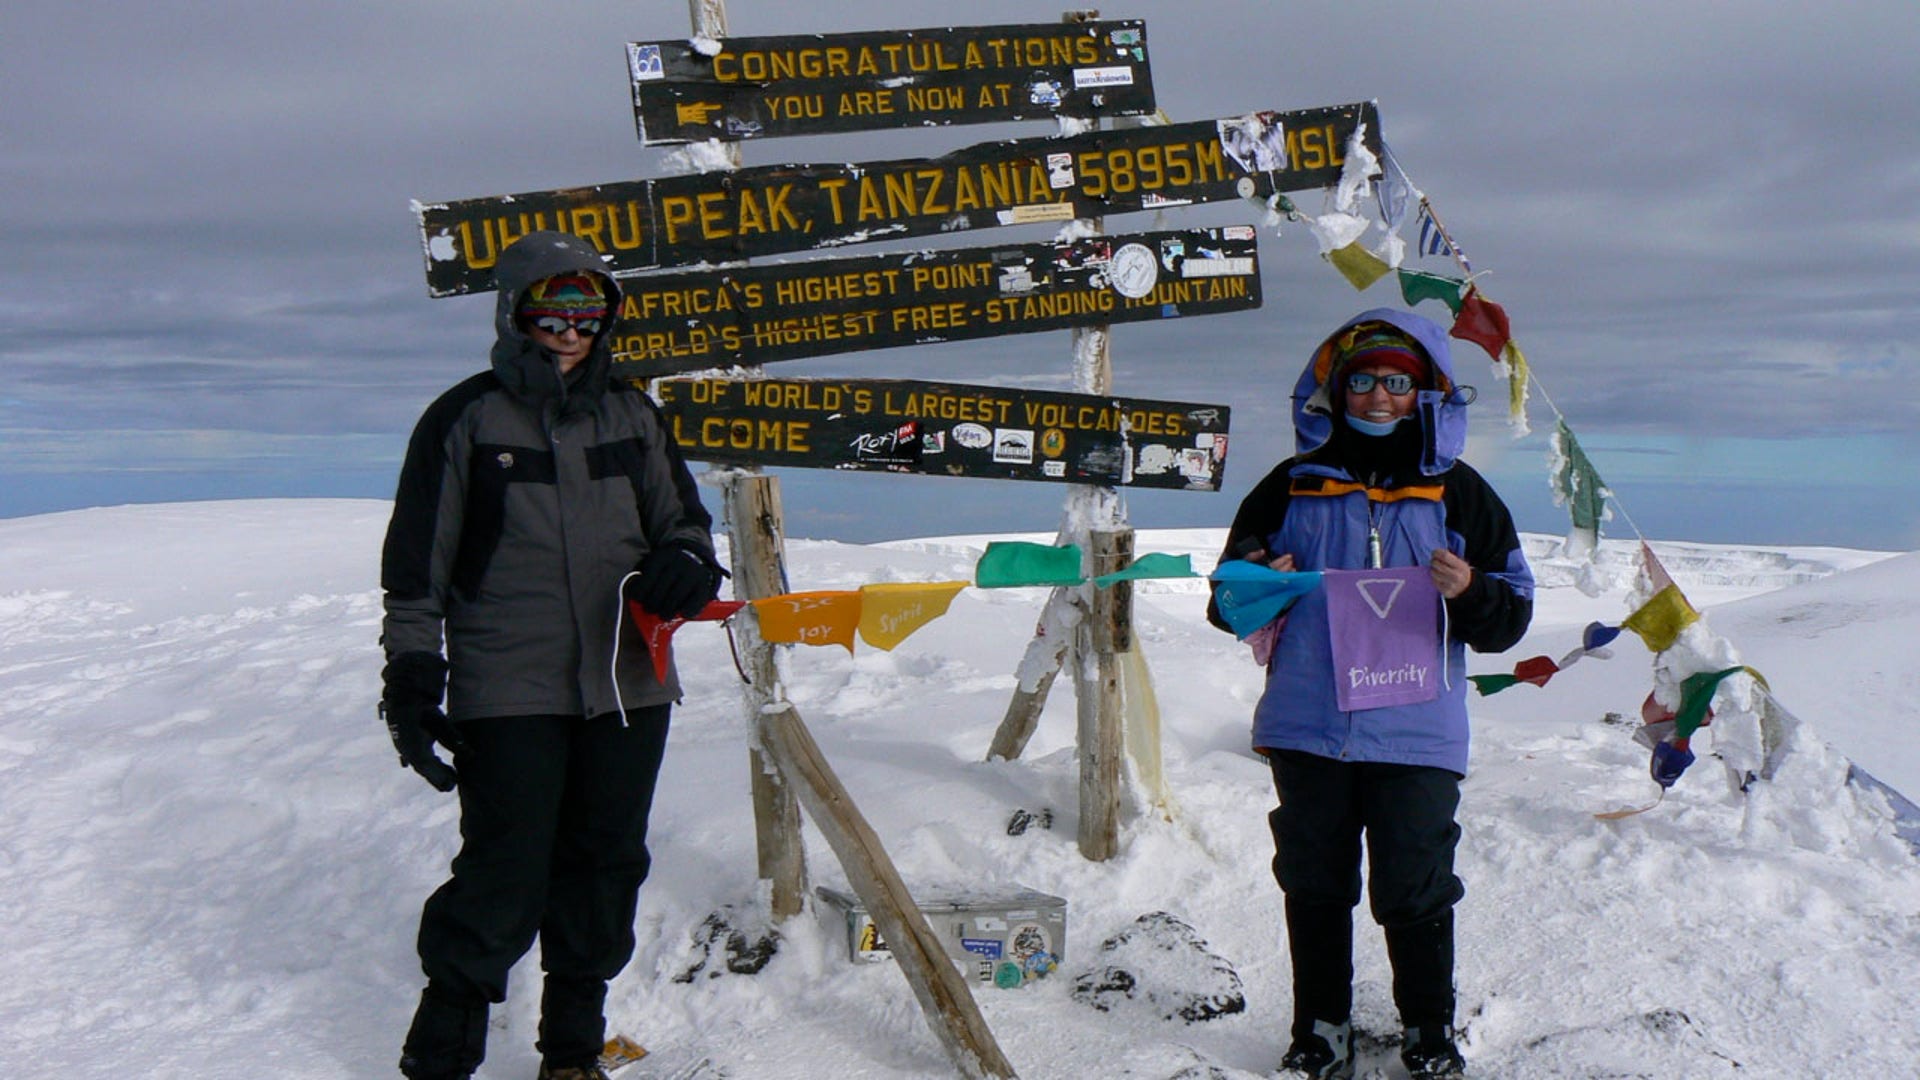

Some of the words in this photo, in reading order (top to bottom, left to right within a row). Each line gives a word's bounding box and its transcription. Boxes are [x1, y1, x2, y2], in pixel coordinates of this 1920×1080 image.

[764, 94, 824, 120] YOU
[838, 91, 895, 116] ARE
[907, 84, 966, 112] NOW
[978, 84, 1012, 109] AT
[664, 183, 813, 245] PEAK,
[819, 162, 1066, 224] TANZANIA,
[623, 280, 764, 321] AFRICA'S
[776, 269, 899, 305] HIGHEST
[912, 263, 993, 293] POINT
[754, 310, 877, 348] HIGHEST
[892, 289, 1116, 332] FREE-STANDING
[691, 380, 731, 405] OF
[744, 382, 873, 415] WORLD'S
[884, 390, 1012, 423] LARGEST
[1348, 663, 1427, 689] Diversity
